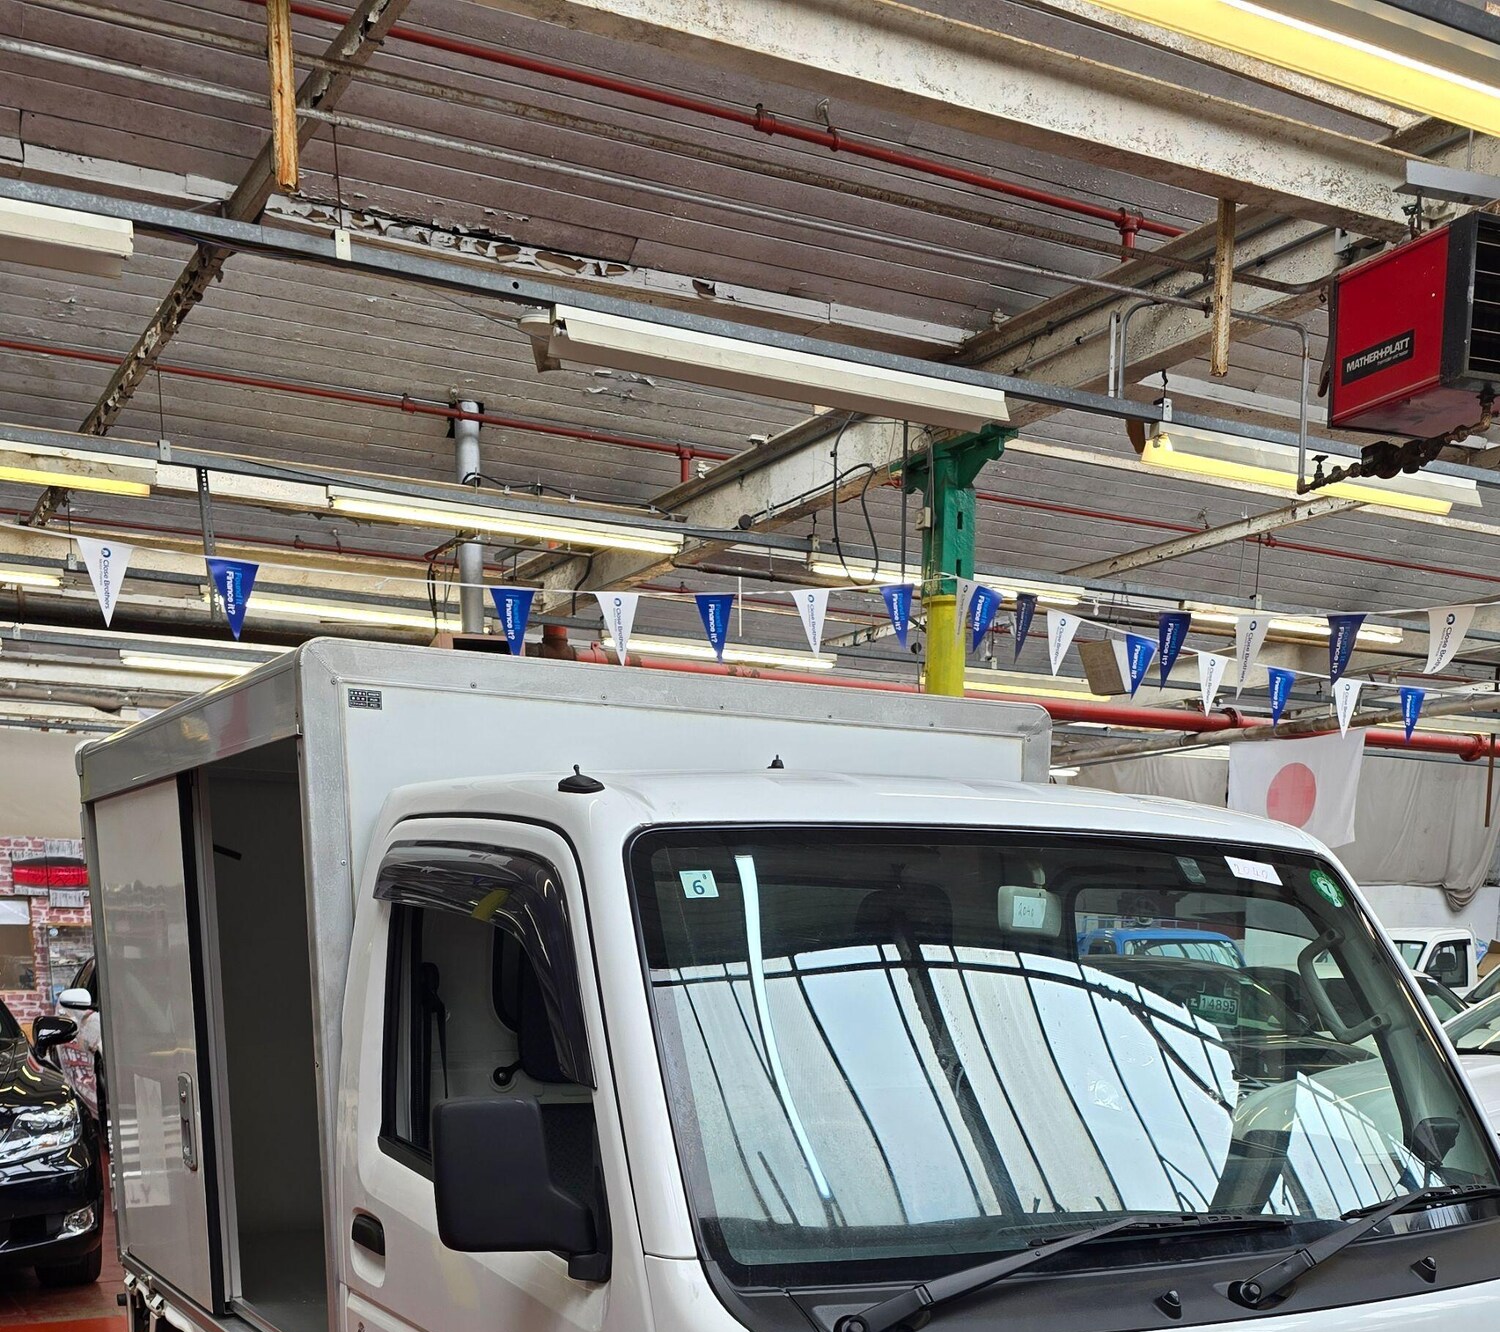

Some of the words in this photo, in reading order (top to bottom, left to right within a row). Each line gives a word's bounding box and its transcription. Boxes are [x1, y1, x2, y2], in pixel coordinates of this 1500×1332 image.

[226, 571, 235, 602] Finance
[234, 572, 242, 598] Found
[708, 604, 716, 632] Finance
[892, 594, 900, 620] Finance
[974, 595, 985, 621] Finance
[1163, 622, 1174, 654] Finance
[1333, 626, 1344, 661] Finance
[1132, 644, 1141, 669] Finance
[692, 879, 705, 895] 6
[1202, 997, 1236, 1013] 14895
